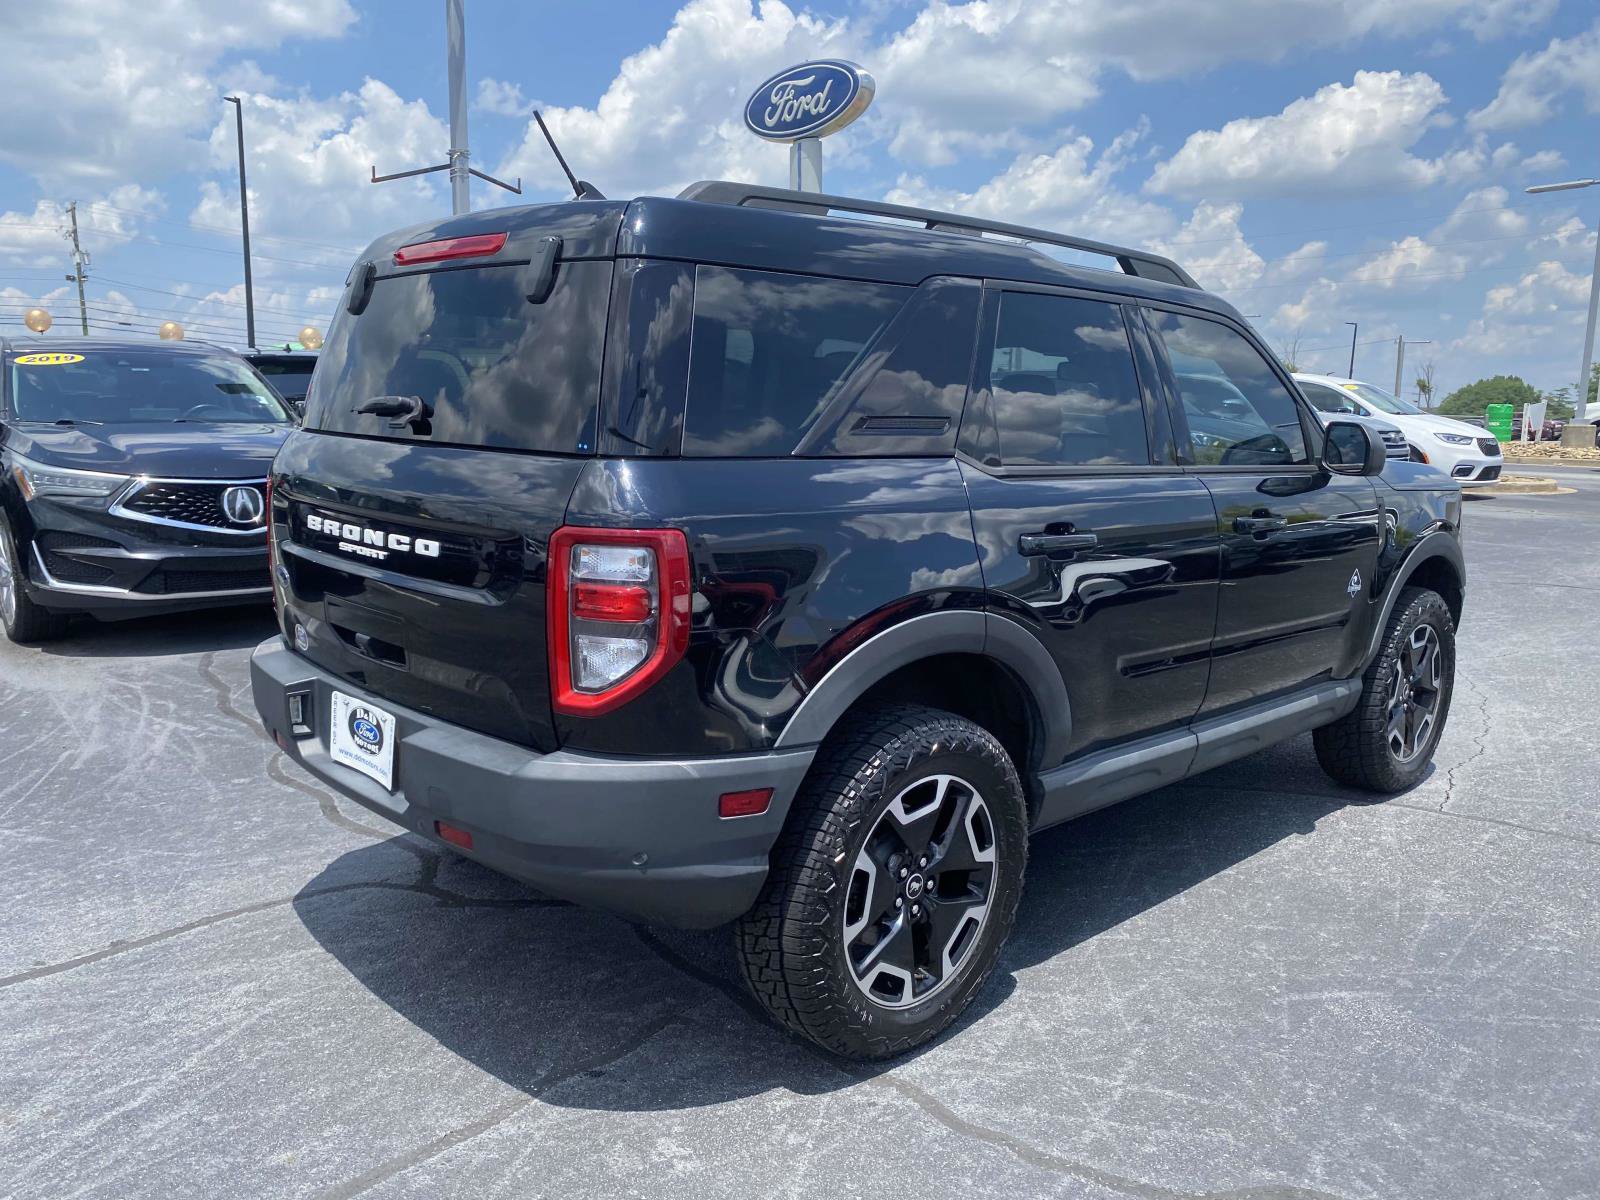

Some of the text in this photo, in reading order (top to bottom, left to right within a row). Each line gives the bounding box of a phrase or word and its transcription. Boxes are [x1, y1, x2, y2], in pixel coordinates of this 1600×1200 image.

[764, 75, 834, 127] Ford
[25, 355, 76, 363] 2019
[307, 514, 441, 558] BRONCO
[338, 541, 390, 560] SPORT
[356, 708, 378, 726] D&D
[358, 722, 376, 741] Ford
[354, 734, 380, 754] MOTORS
